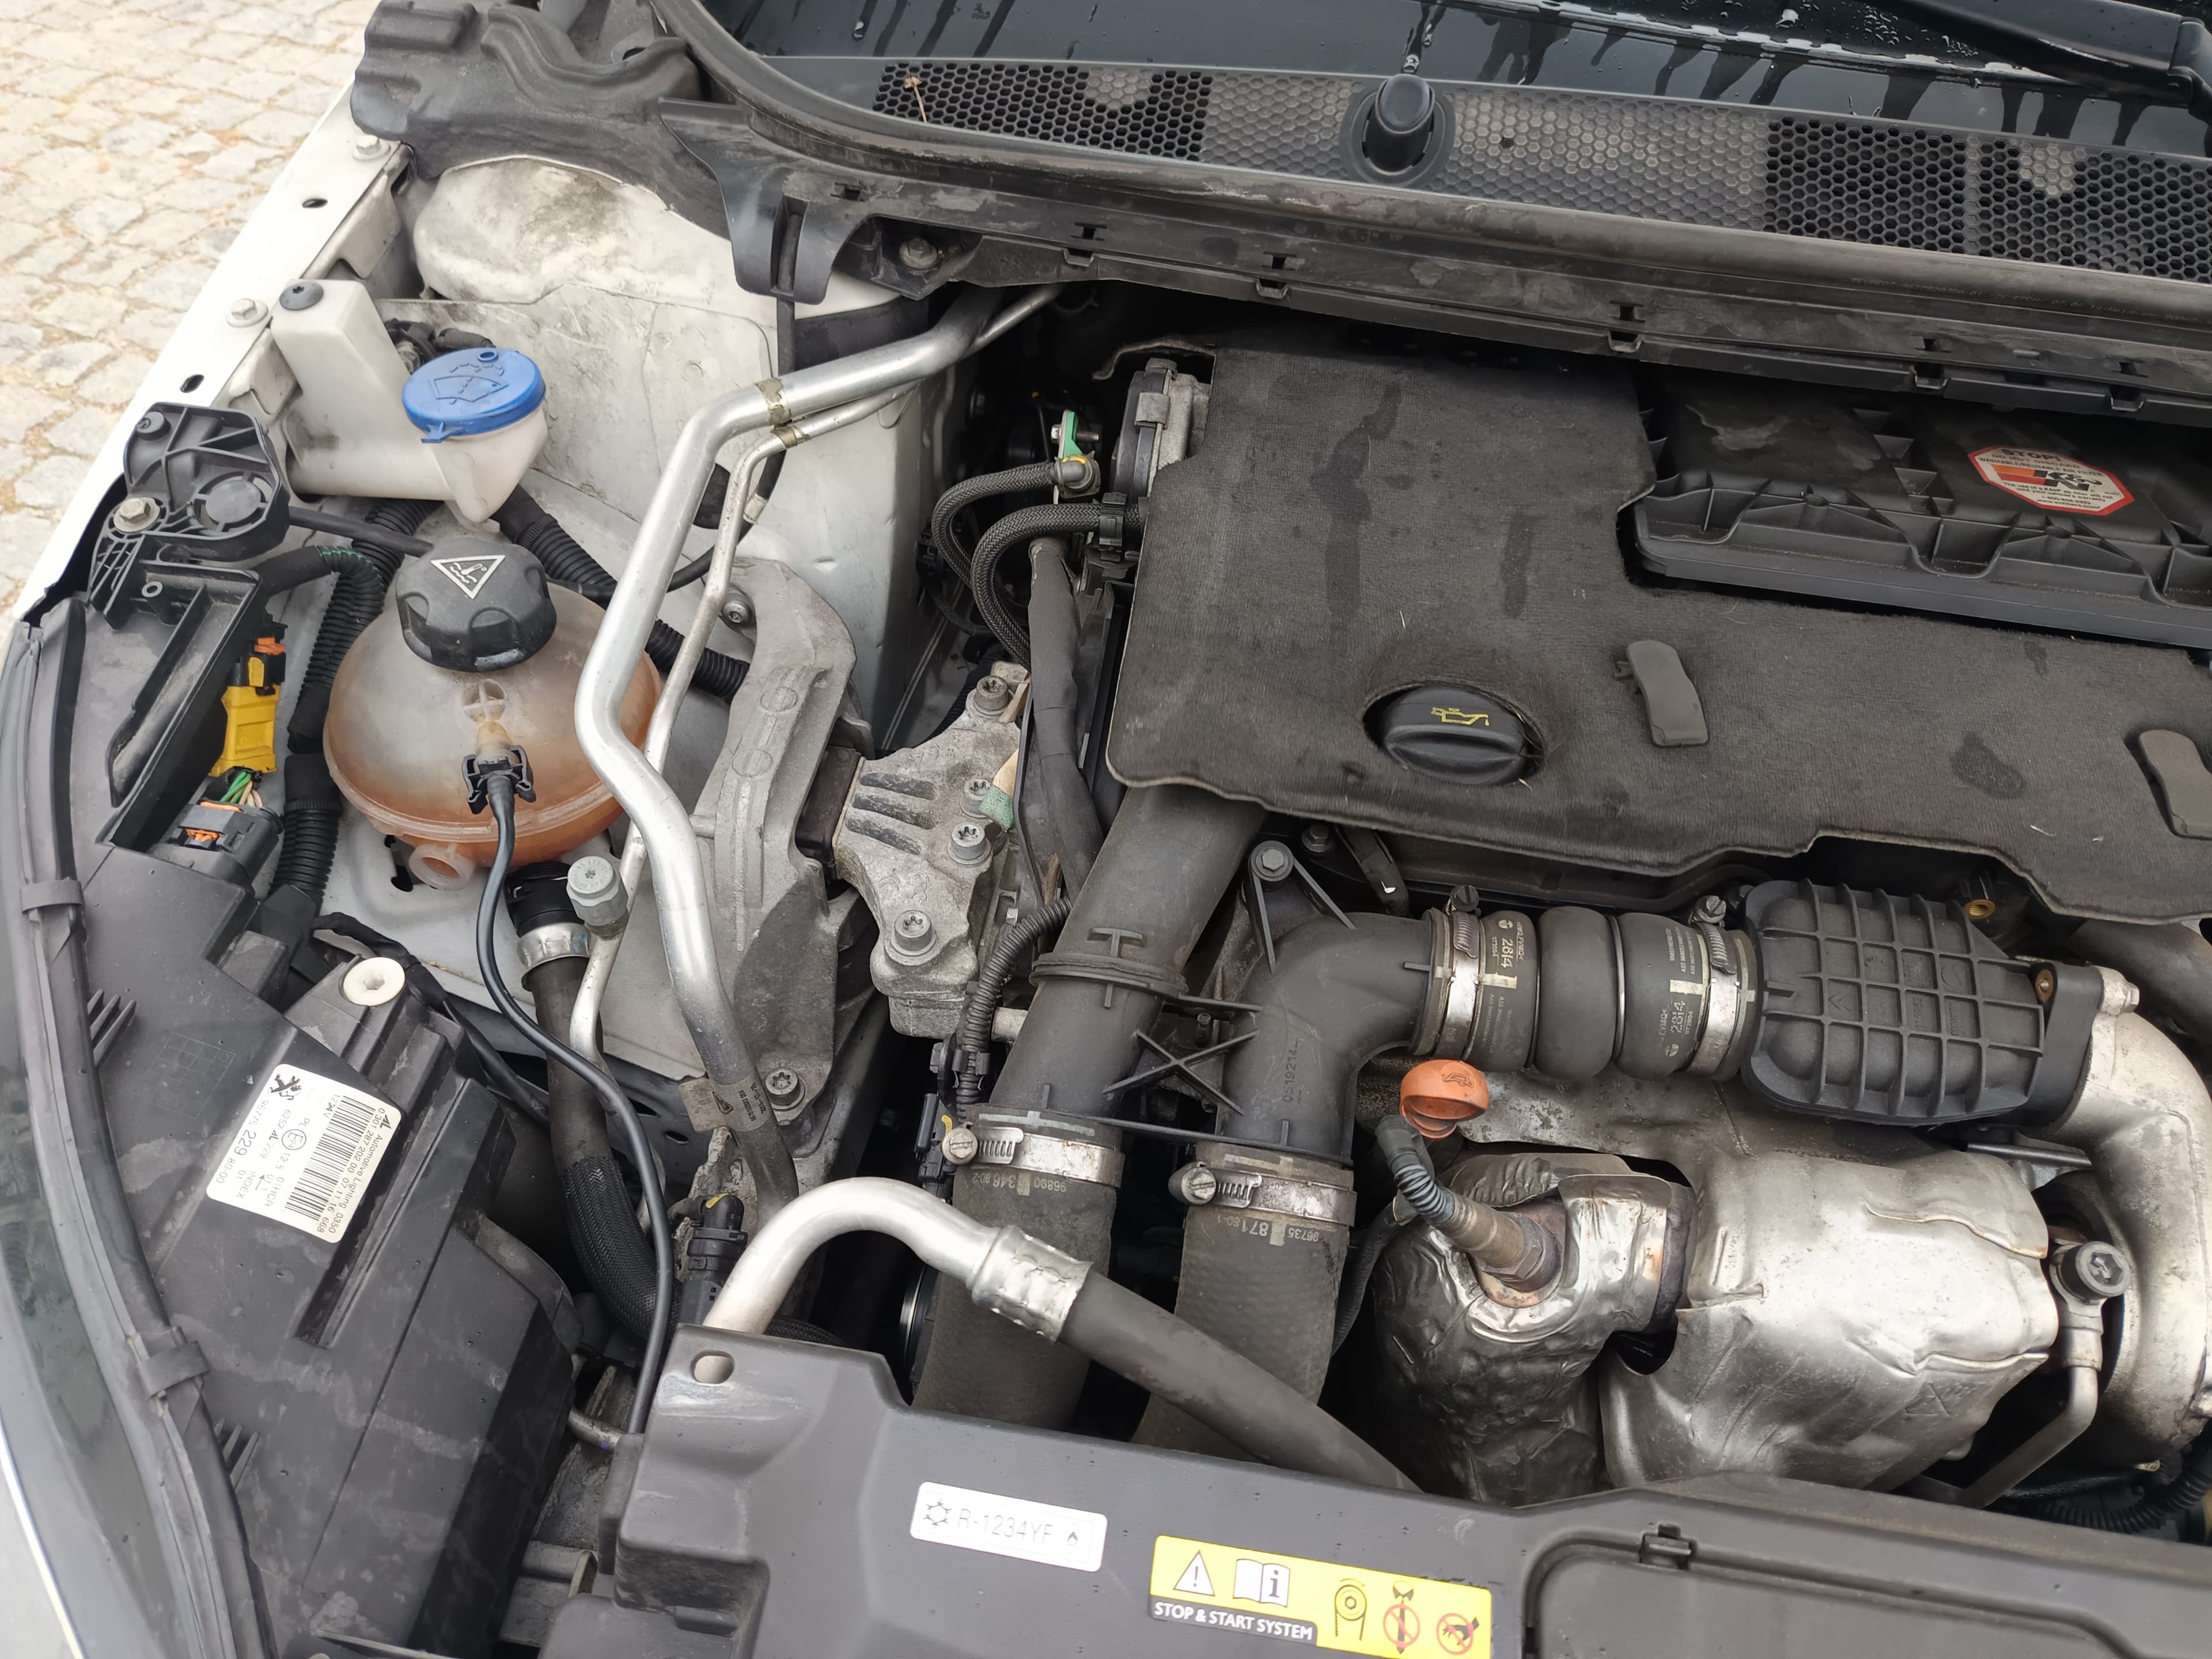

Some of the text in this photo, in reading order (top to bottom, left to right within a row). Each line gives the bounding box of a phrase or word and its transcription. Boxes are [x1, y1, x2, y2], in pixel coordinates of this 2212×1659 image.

[2000, 448, 2061, 461] STOP!
[1979, 457, 2060, 471] WASHABLE/REUSABLE
[2034, 460, 2080, 468] DISCARD
[2035, 469, 2102, 493] K&N
[1500, 937, 1513, 968] 2814
[276, 1109, 291, 1129] 6252
[298, 1117, 310, 1126] PL
[370, 1113, 382, 1129] 301
[215, 1100, 269, 1184] 96775 229 80-00
[362, 1129, 374, 1146] 287
[259, 1142, 274, 1158] 229
[353, 1145, 366, 1162] 202
[356, 1133, 383, 1176] Automotive
[235, 1169, 247, 1179] 01
[346, 1161, 357, 1173] 00
[236, 1171, 256, 1199] INDEX
[338, 1177, 362, 1209] Lighting
[316, 1216, 329, 1233] 668
[327, 1211, 344, 1233] 0350
[1241, 1219, 1269, 1237] 871
[958, 1508, 1054, 1544] R-1234YF
[1155, 1602, 1312, 1640] STOP & START SYSTEM
